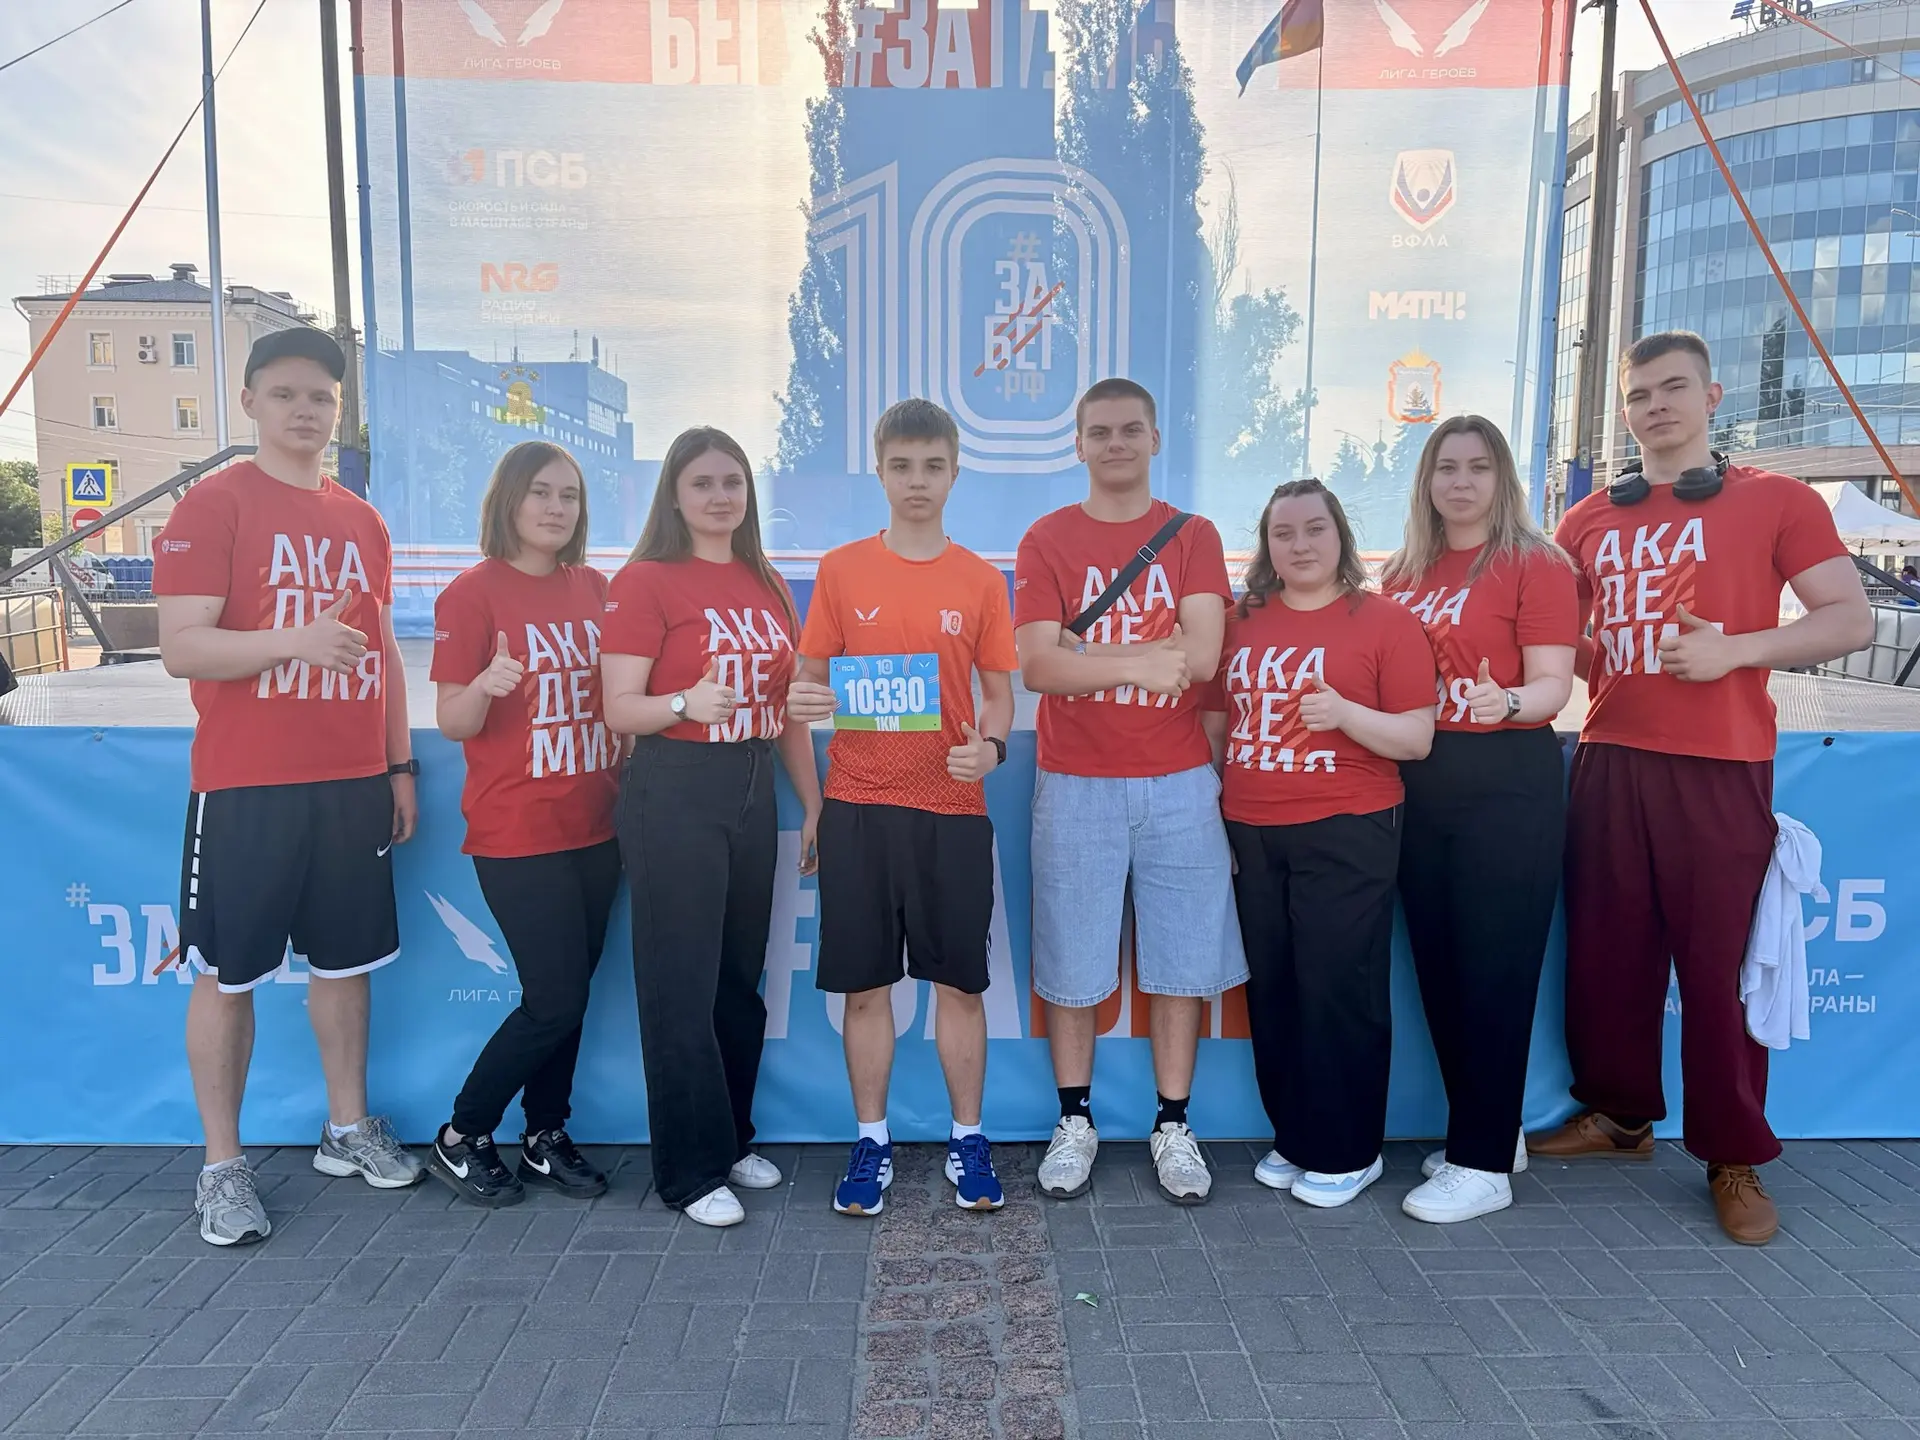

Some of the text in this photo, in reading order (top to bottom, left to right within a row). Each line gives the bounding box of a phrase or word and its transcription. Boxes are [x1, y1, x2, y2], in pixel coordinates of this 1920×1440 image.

[463, 57, 562, 70] ЛИГА ГЕРОЕВ
[1378, 67, 1477, 80] ЛИГА ГЕРОЕВ
[496, 150, 588, 189] ПСБ
[1391, 233, 1449, 247] ВФЛА
[480, 261, 560, 293] NRG
[994, 260, 1053, 316] ЗА
[1368, 290, 1467, 320] МАТЧ!
[984, 315, 1064, 370] БЕГ
[268, 533, 371, 593] АКА
[1594, 517, 1708, 576] АКА
[1601, 568, 1667, 626] ДЕ
[703, 607, 794, 652] АКА
[939, 608, 963, 636] 10
[1226, 646, 1326, 692] АКА
[1600, 621, 1725, 677] МИ
[532, 669, 594, 725] ДЕ
[716, 653, 773, 704] ДЕ
[844, 676, 926, 715] 10330
[1231, 692, 1289, 743] ДЕ
[447, 988, 501, 1003] ЛИГА
